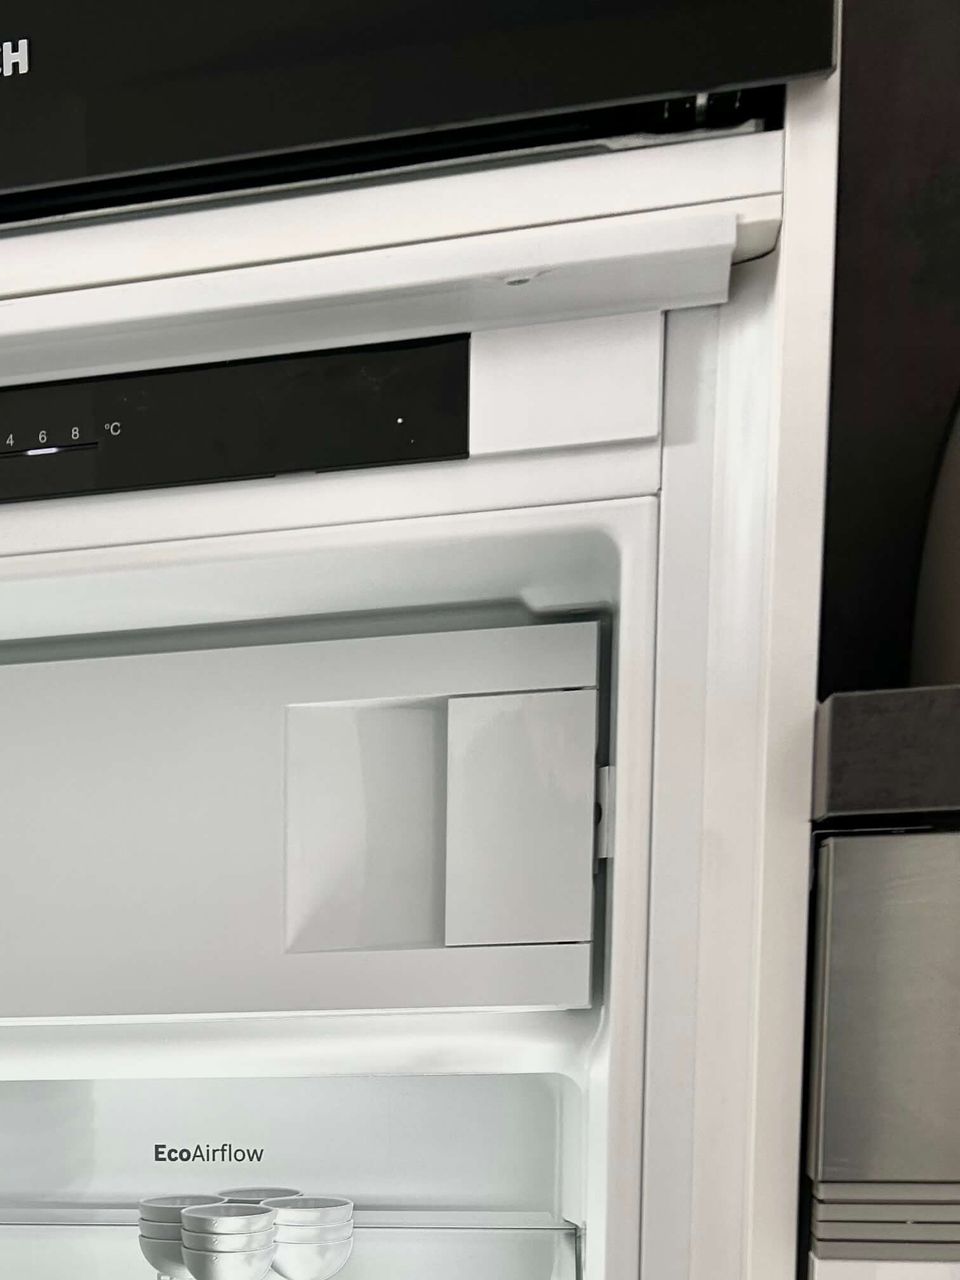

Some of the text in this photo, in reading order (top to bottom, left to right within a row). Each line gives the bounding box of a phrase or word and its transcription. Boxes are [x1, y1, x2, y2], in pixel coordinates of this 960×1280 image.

[6, 434, 15, 447] 4
[38, 430, 48, 443] 6
[71, 427, 80, 440] 8
[154, 1143, 264, 1162] EcoAirflow
